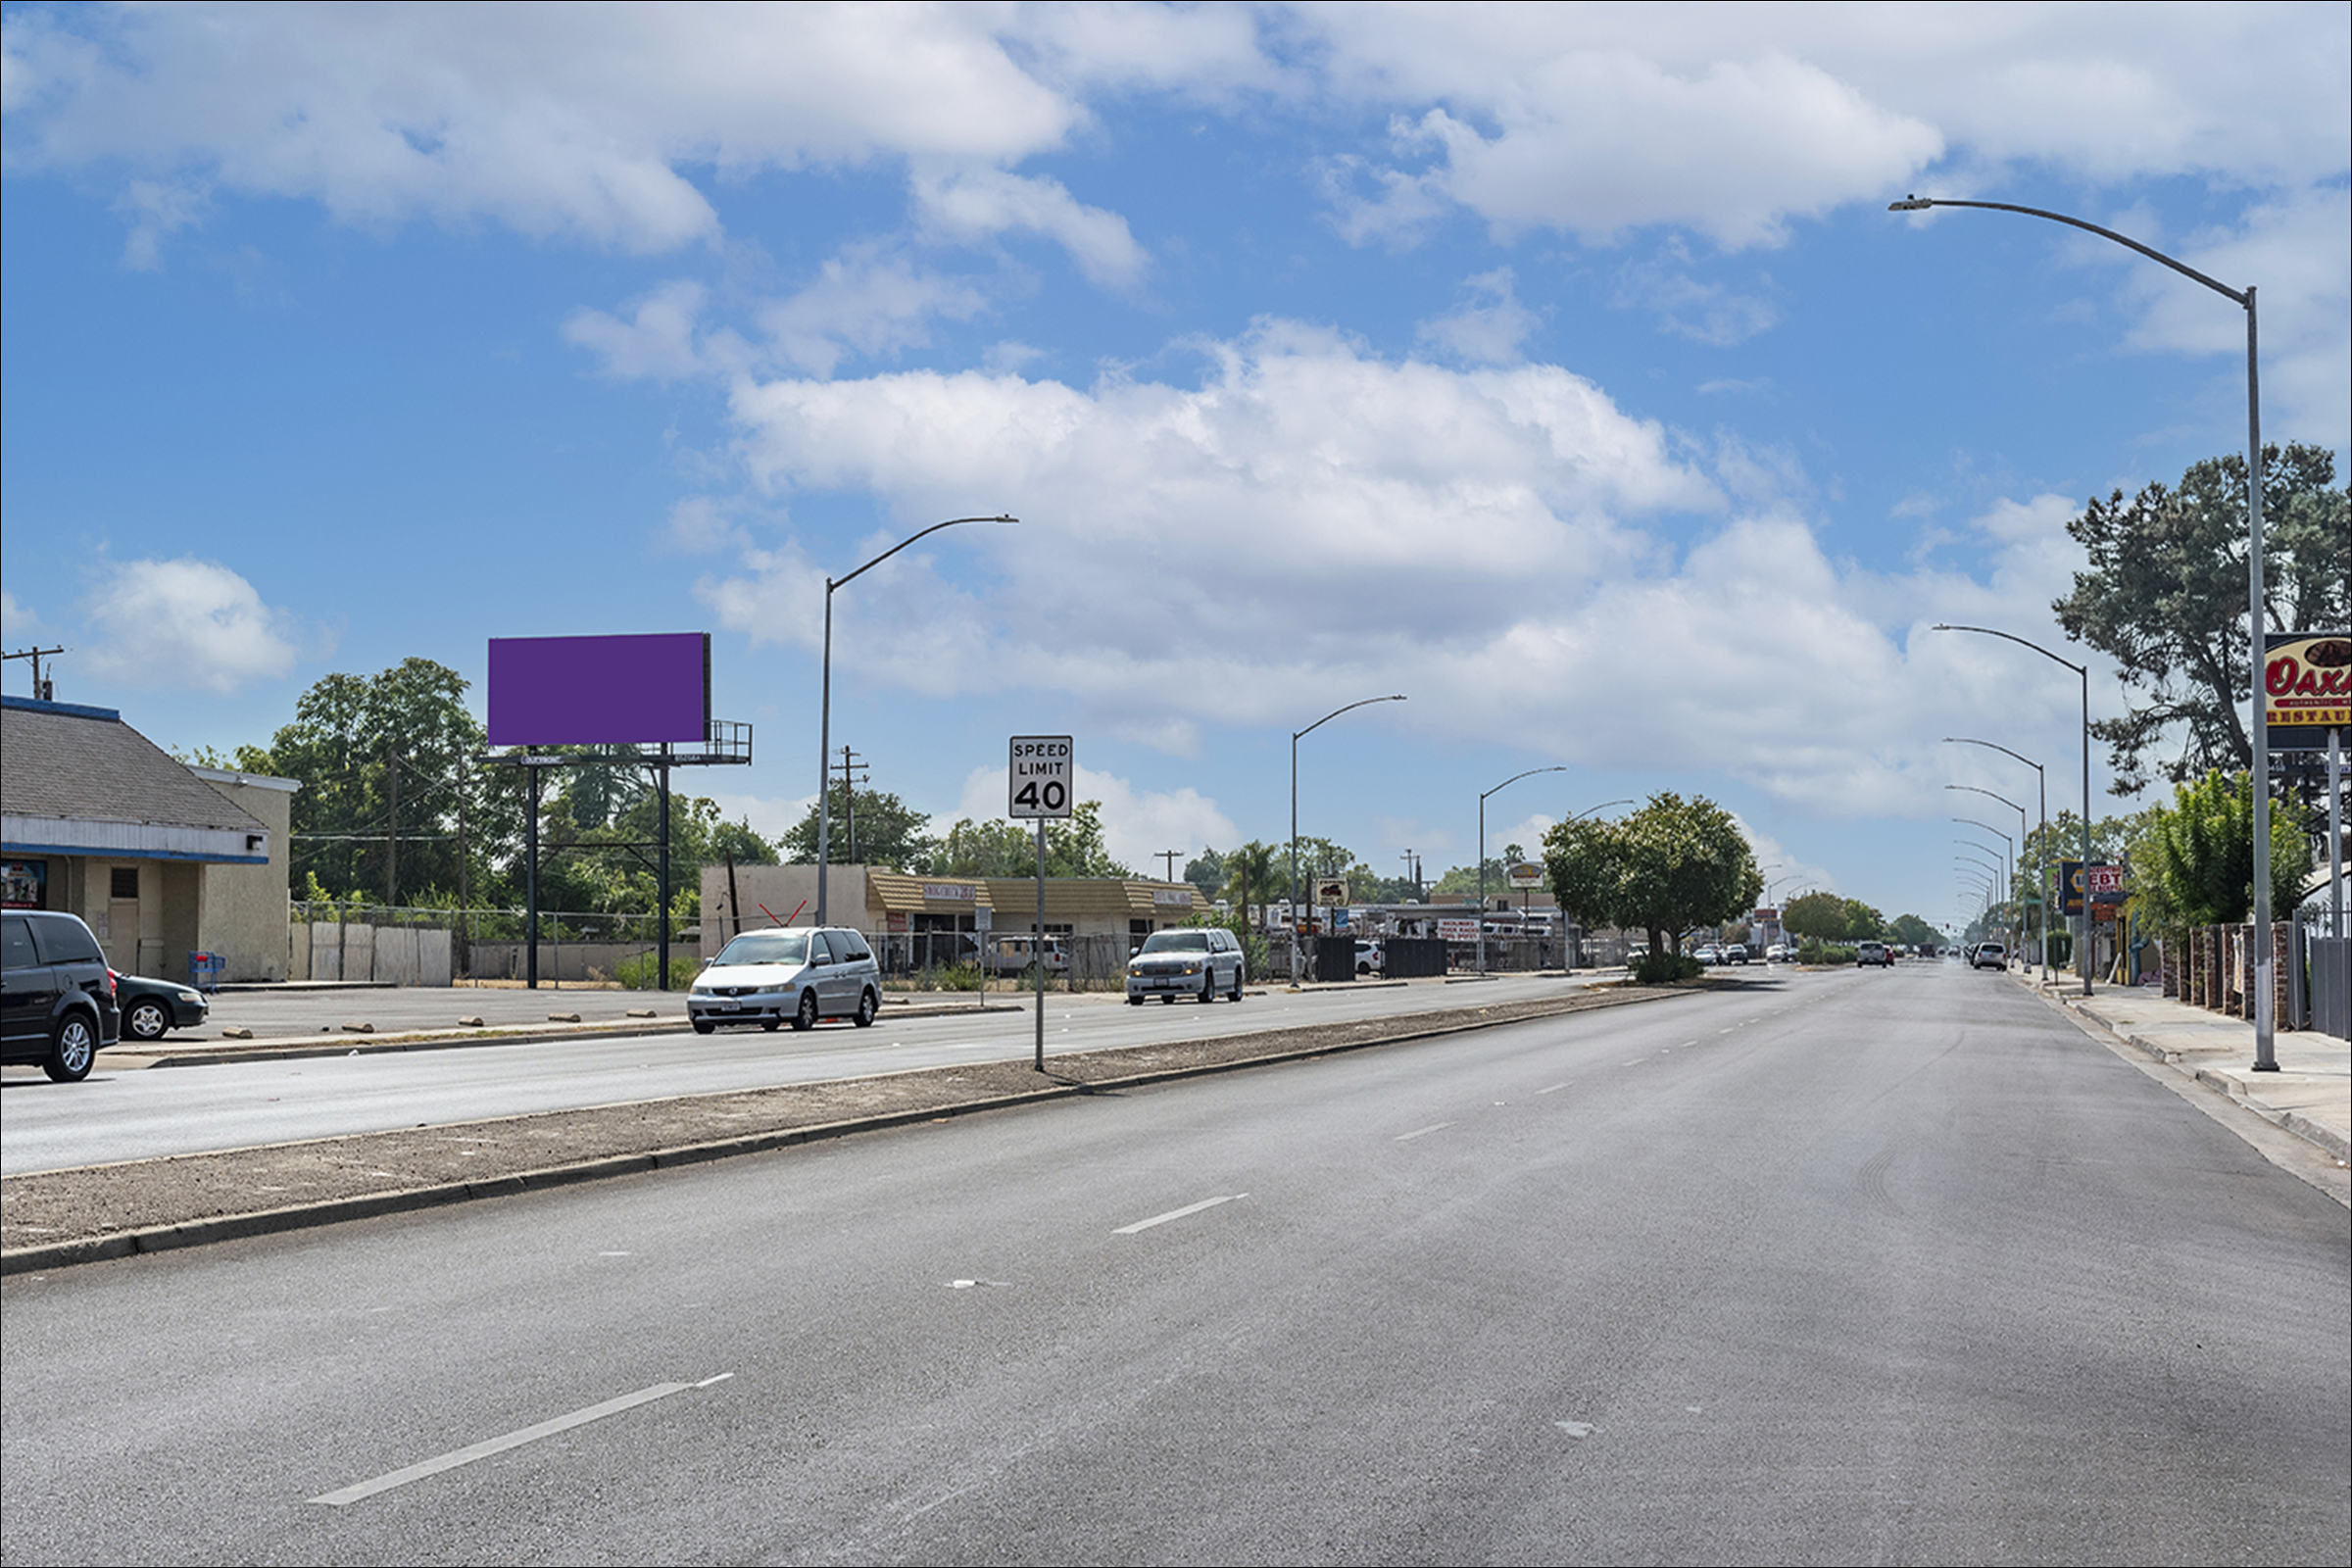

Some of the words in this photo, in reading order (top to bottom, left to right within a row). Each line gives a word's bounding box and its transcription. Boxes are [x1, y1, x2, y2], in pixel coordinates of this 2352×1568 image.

[2267, 710, 2351, 723] RESTAU
[1014, 744, 1068, 757] SPEED
[1019, 762, 1063, 775] LIMIT
[1014, 780, 1065, 810] 40
[2089, 873, 2122, 885] EBT
